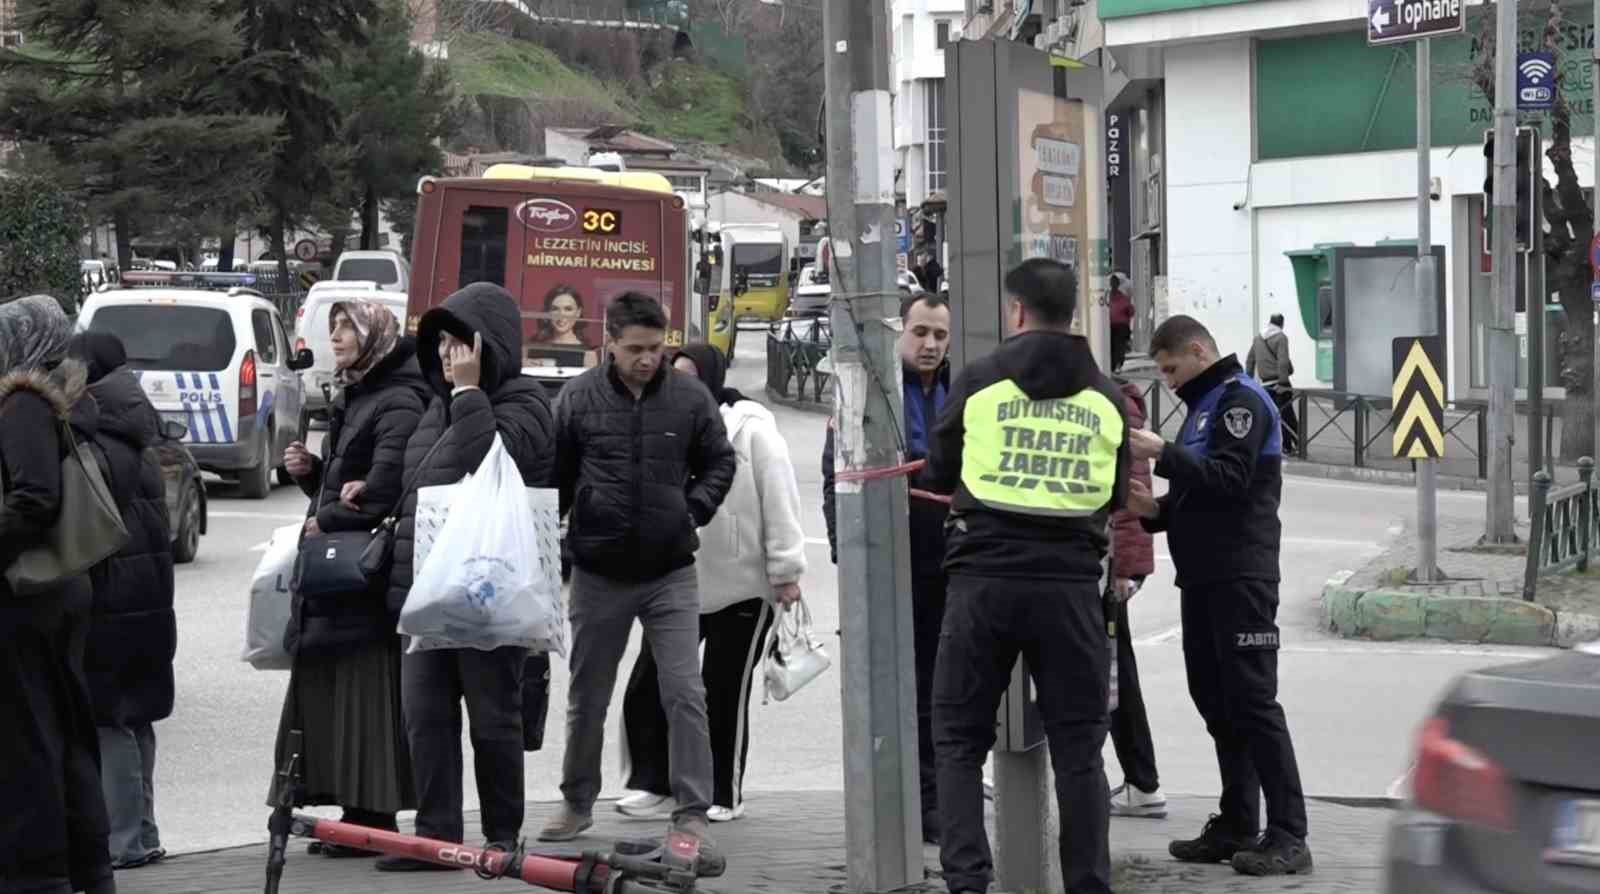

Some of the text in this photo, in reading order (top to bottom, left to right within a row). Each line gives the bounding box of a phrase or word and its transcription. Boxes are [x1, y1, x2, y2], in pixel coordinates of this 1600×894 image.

[1394, 0, 1459, 31] Tophane
[583, 210, 616, 232] 3C
[535, 237, 601, 252] LEZZETİN
[527, 252, 655, 271] MİRVARİ KAHVESİ
[999, 451, 1090, 481] ZABITA
[1236, 632, 1278, 646] ZABITA
